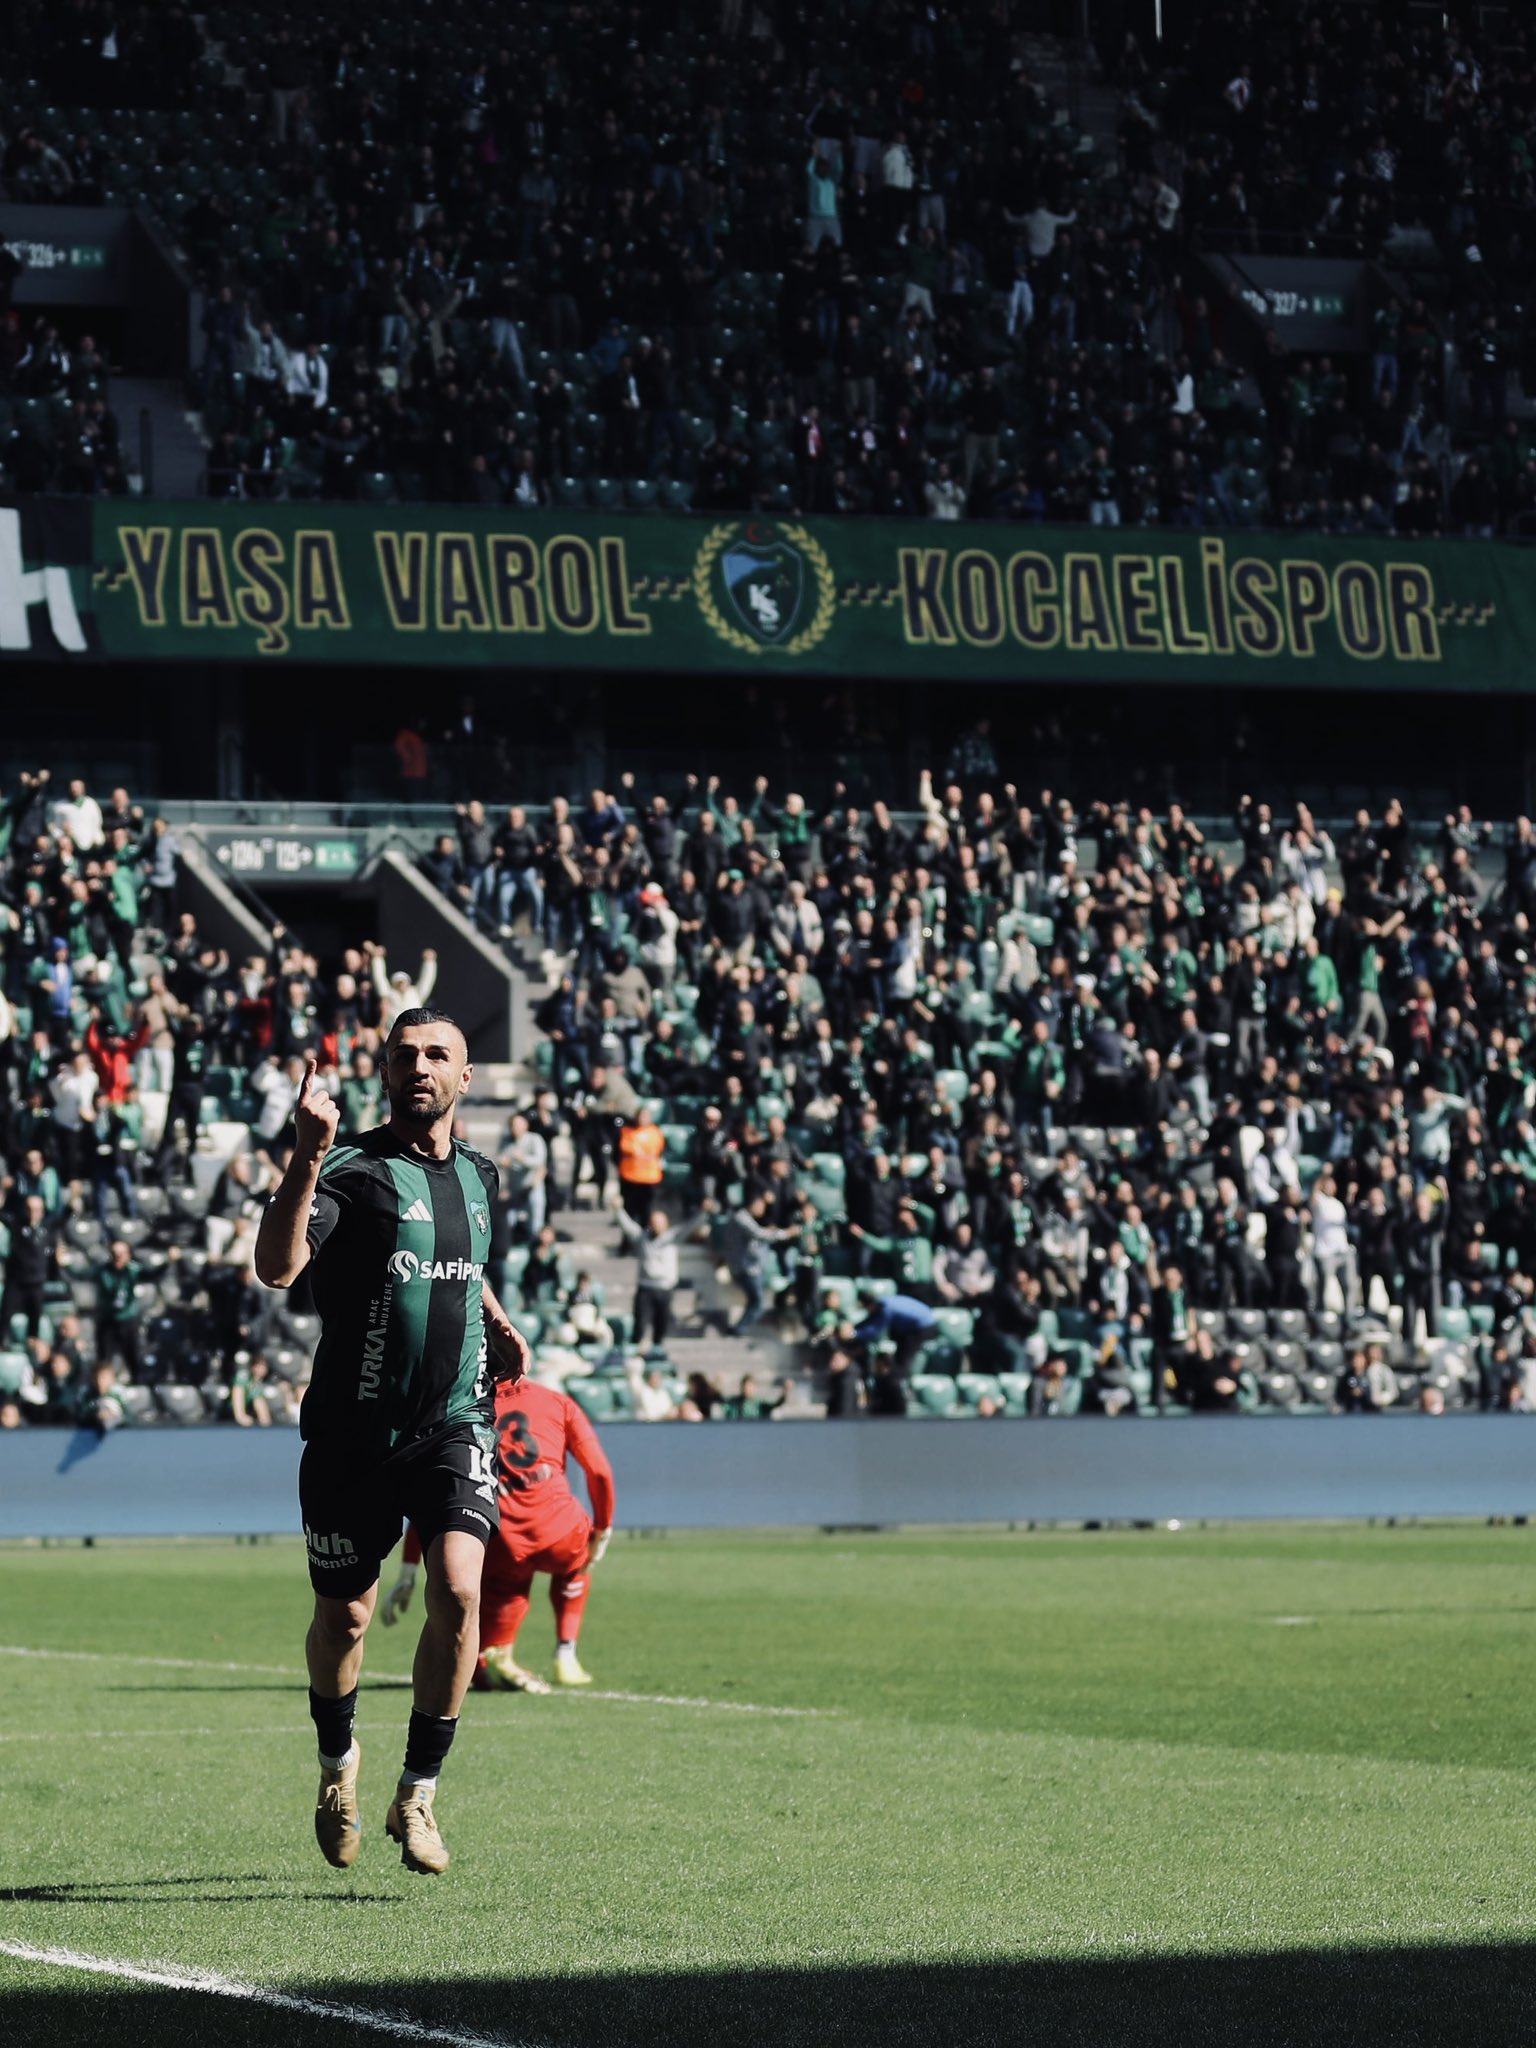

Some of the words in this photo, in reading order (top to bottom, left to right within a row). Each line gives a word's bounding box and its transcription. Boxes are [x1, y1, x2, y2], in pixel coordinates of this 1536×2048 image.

[117, 526, 352, 653] YAŞA
[374, 531, 652, 635] VAROL
[899, 537, 1441, 661] KOCAELİSPOR
